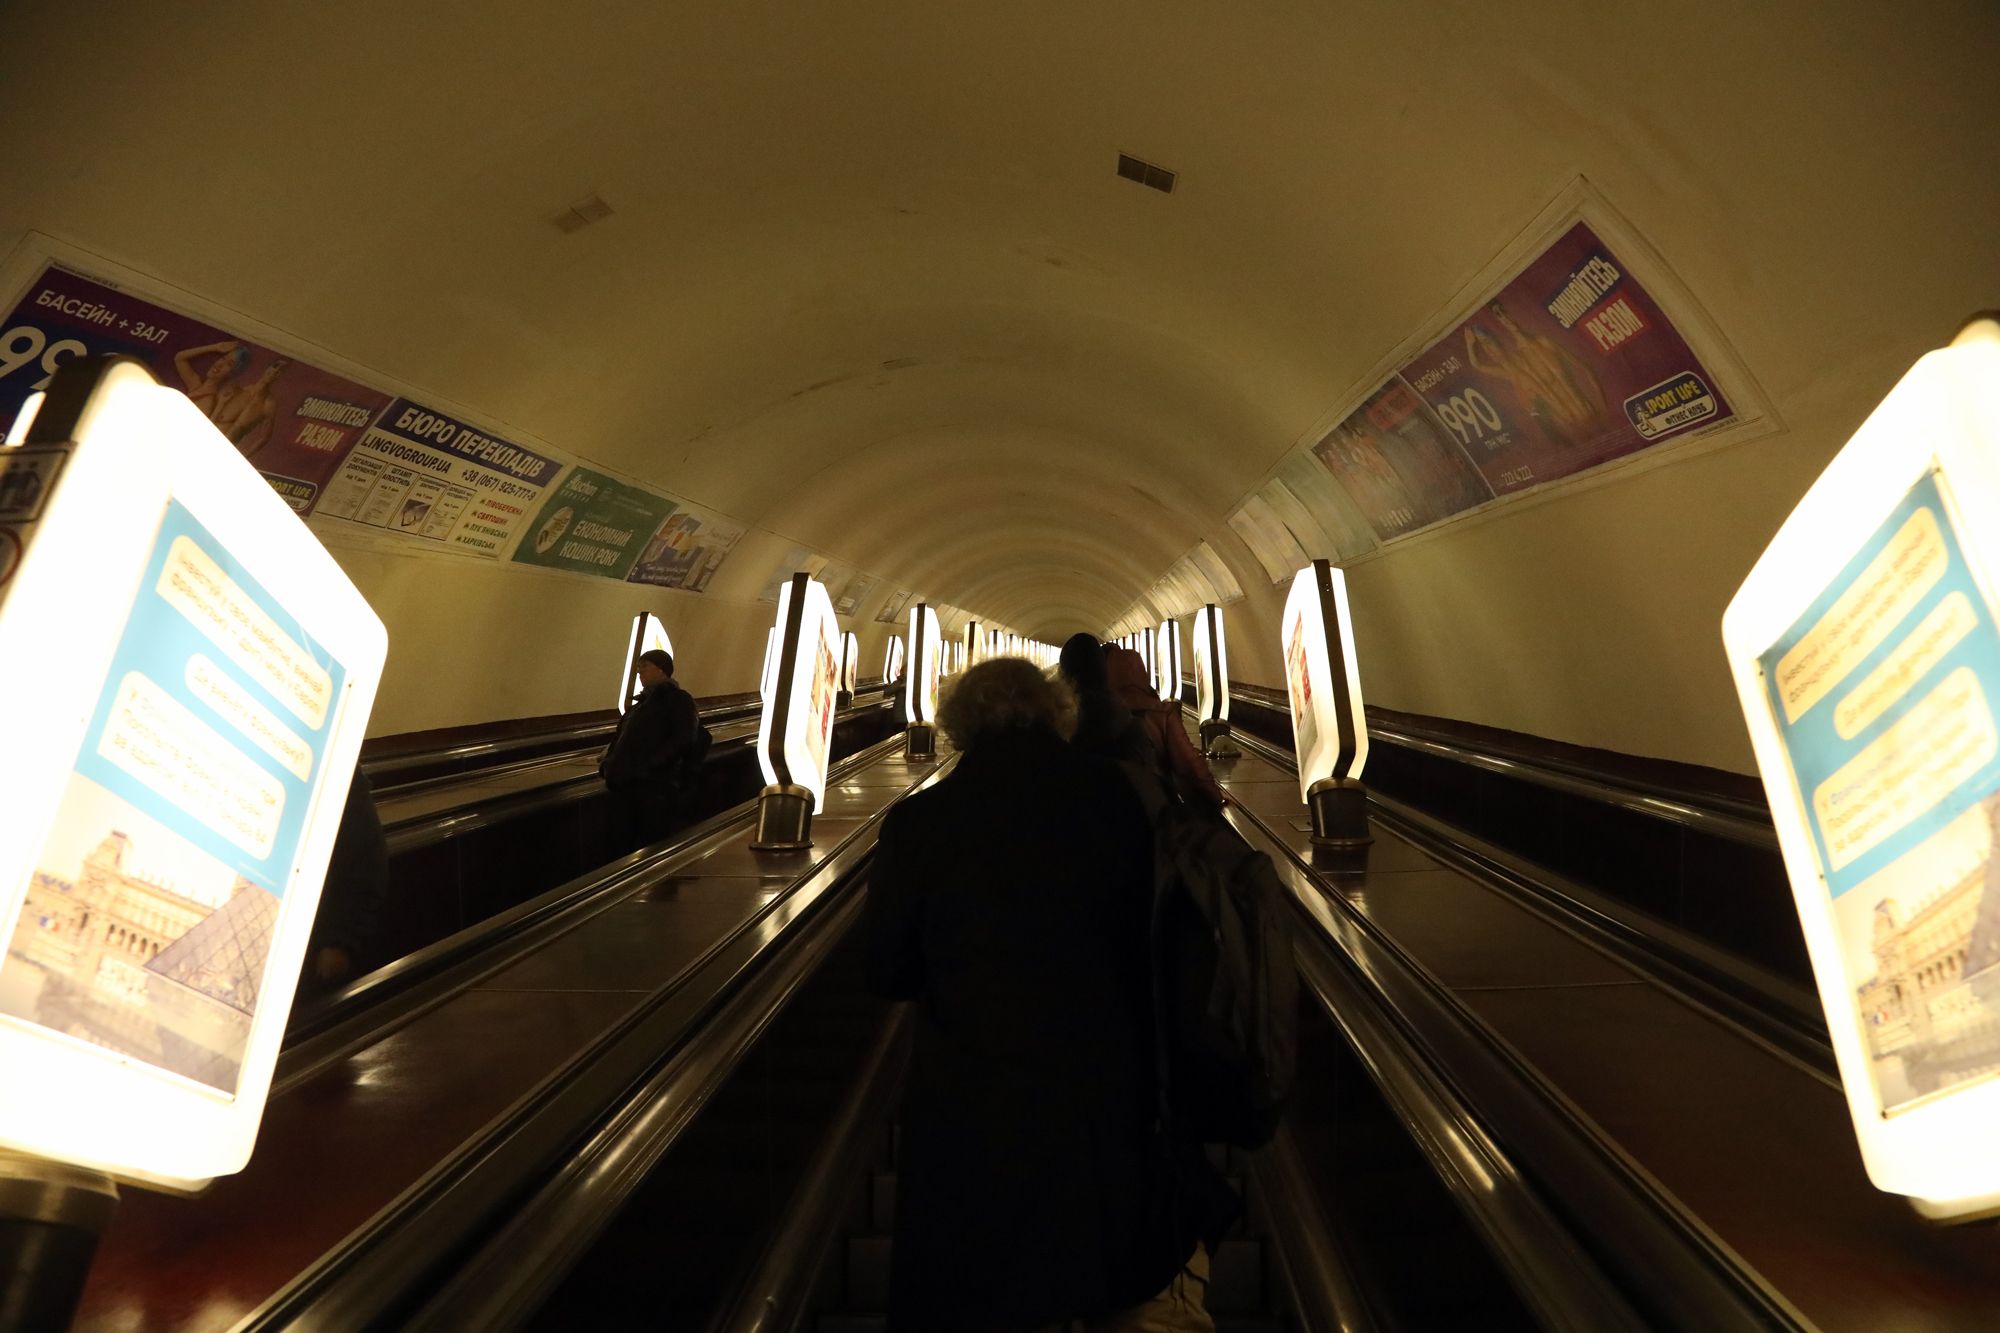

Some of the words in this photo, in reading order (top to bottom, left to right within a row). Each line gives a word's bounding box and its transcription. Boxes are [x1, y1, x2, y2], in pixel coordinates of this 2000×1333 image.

[36, 289, 117, 328] БАСЕЙН
[131, 322, 169, 344] ЗАЛ
[1586, 298, 1644, 350] РАЗОМ
[0, 325, 88, 391] 99
[1437, 387, 1501, 444] 990
[1677, 379, 1701, 400] LIFE
[296, 423, 344, 451] РАЗОМ
[361, 433, 453, 474] LINGVOGROUP.UA
[461, 468, 478, 483] +38
[477, 473, 499, 492] (067)
[395, 408, 455, 443] БЮРО
[450, 429, 545, 477] ПЕРЕКЛАДІВ
[559, 541, 599, 563] КОШИК
[595, 547, 622, 567] РОКУ
